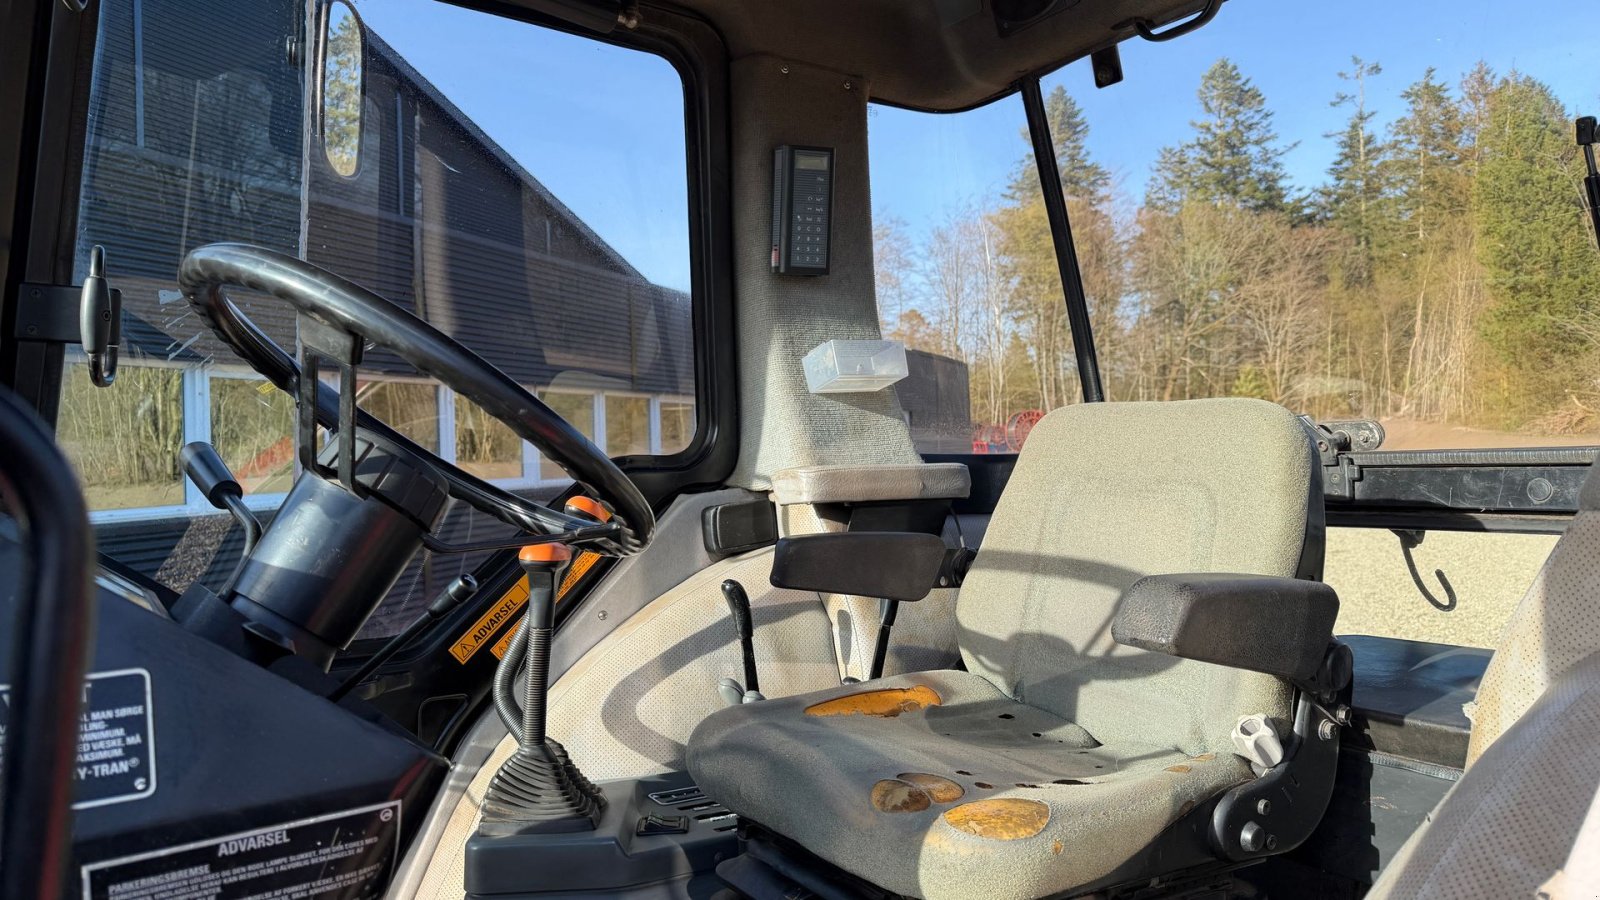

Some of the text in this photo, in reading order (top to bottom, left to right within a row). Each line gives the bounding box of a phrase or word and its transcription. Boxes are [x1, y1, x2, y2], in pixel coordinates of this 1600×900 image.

[473, 599, 518, 644] ADVARSEL
[90, 708, 114, 721] MAN
[217, 830, 291, 857] ADVARSEL
